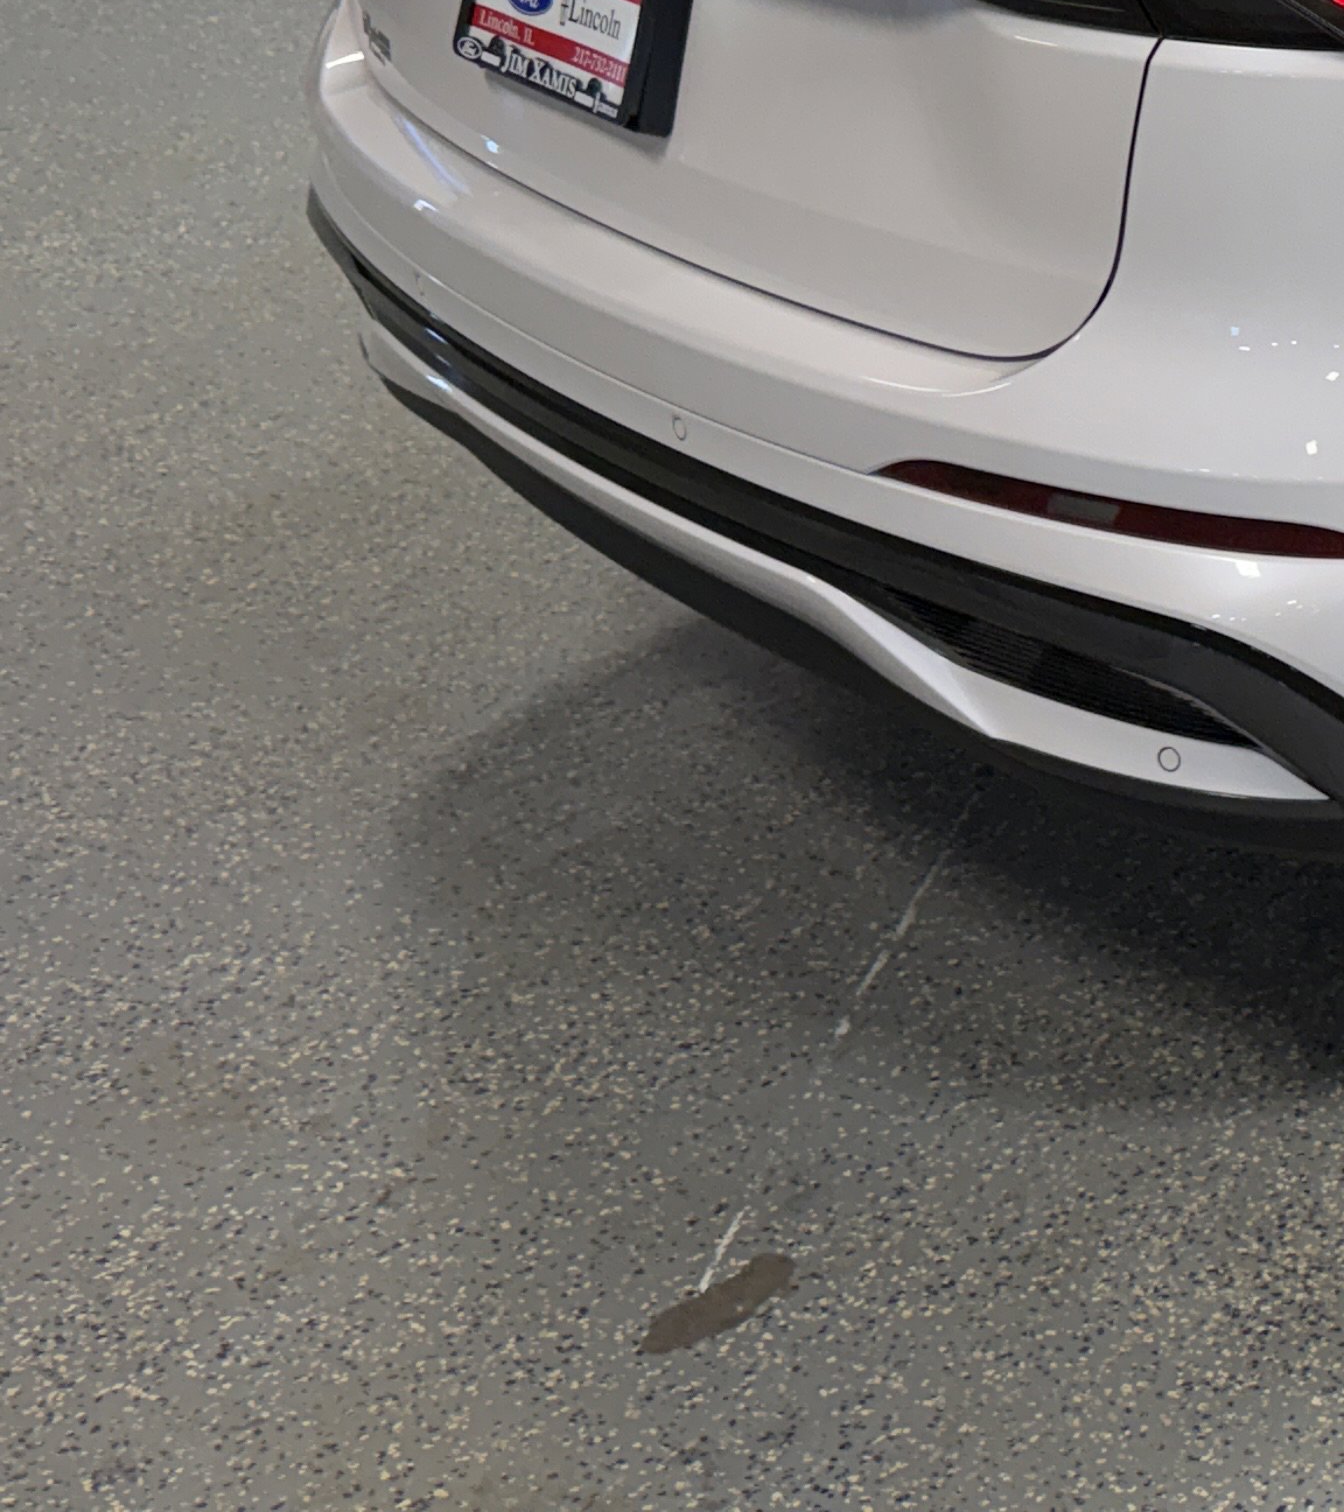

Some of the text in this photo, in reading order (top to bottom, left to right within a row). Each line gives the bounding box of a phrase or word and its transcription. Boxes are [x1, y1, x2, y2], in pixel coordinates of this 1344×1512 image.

[522, 26, 535, 46] IL
[500, 44, 531, 78] JIM
[527, 57, 579, 99] XAMIS
